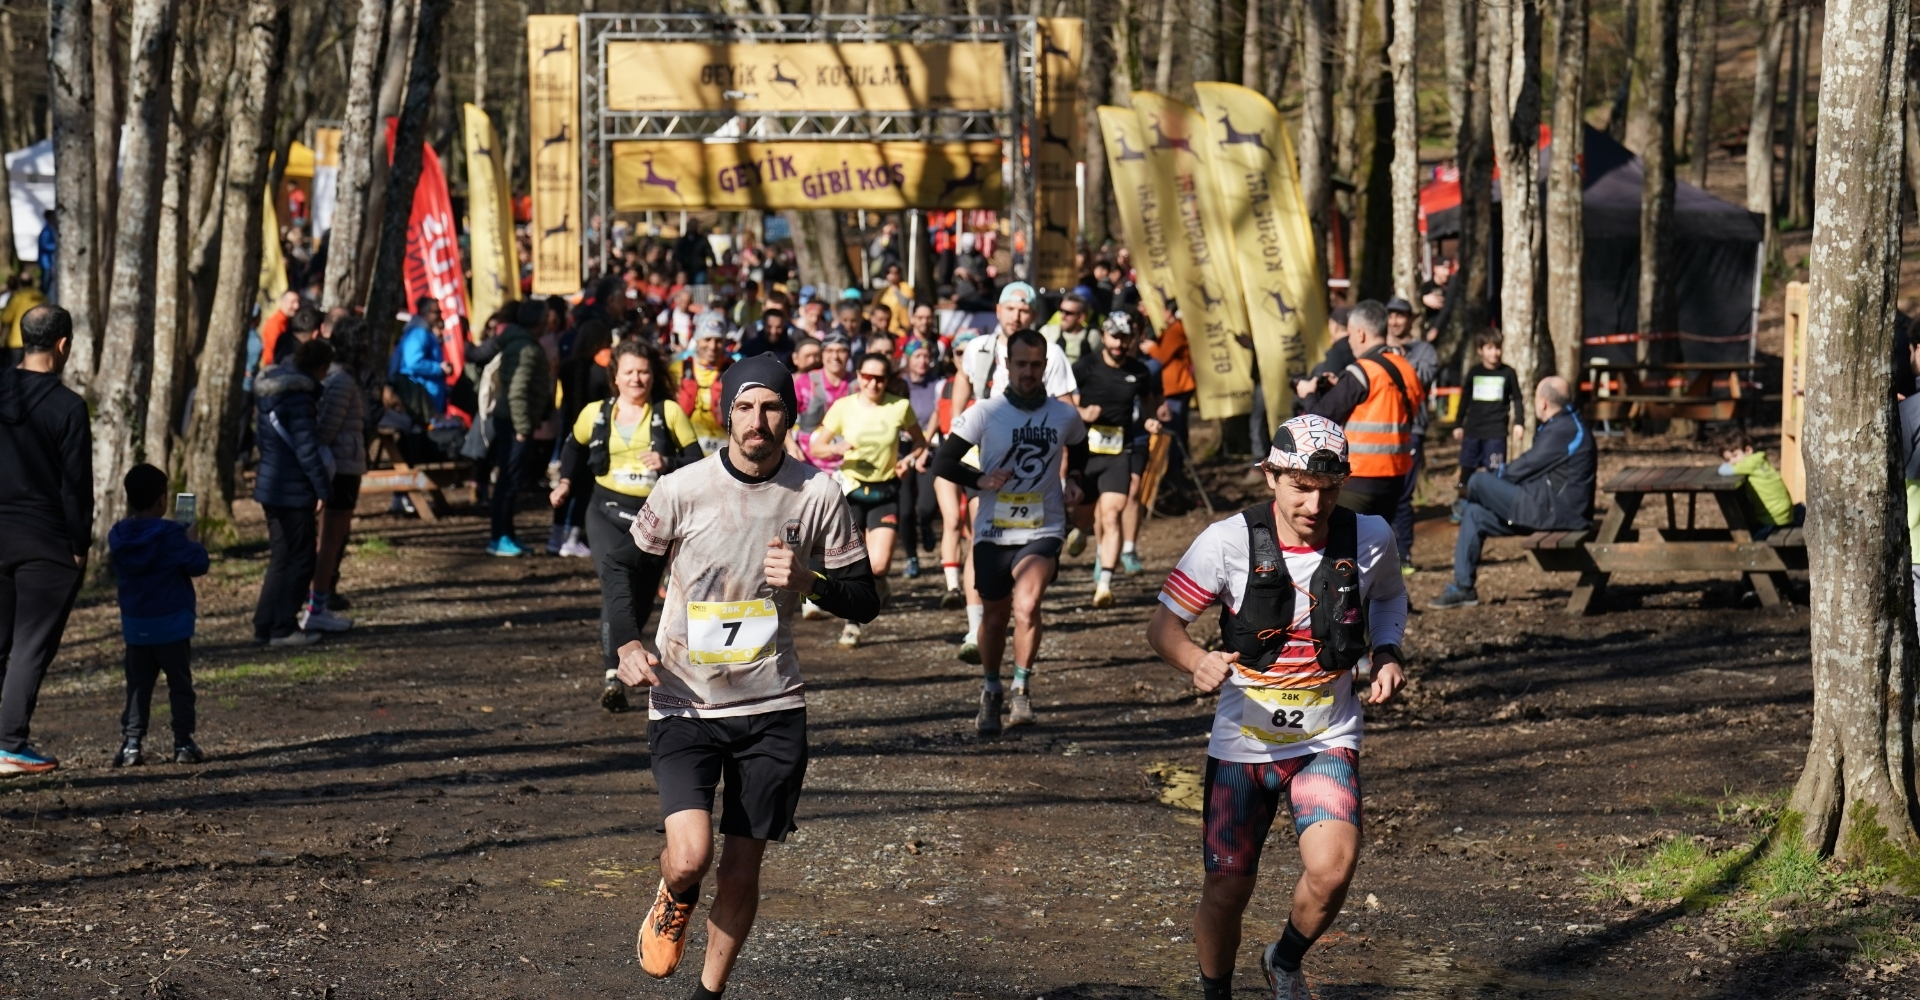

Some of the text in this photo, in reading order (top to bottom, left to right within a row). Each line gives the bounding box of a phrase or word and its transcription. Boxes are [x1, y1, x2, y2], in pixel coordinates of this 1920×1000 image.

[701, 62, 757, 87] GEYİK
[718, 150, 797, 193] GEYİK
[802, 161, 852, 200] GİBİ
[1012, 426, 1058, 445] BADGERS
[1010, 506, 1029, 518] 79
[722, 606, 740, 614] 28K
[722, 621, 743, 647] 7
[1281, 692, 1300, 701] 28K
[1271, 708, 1305, 729] 82
